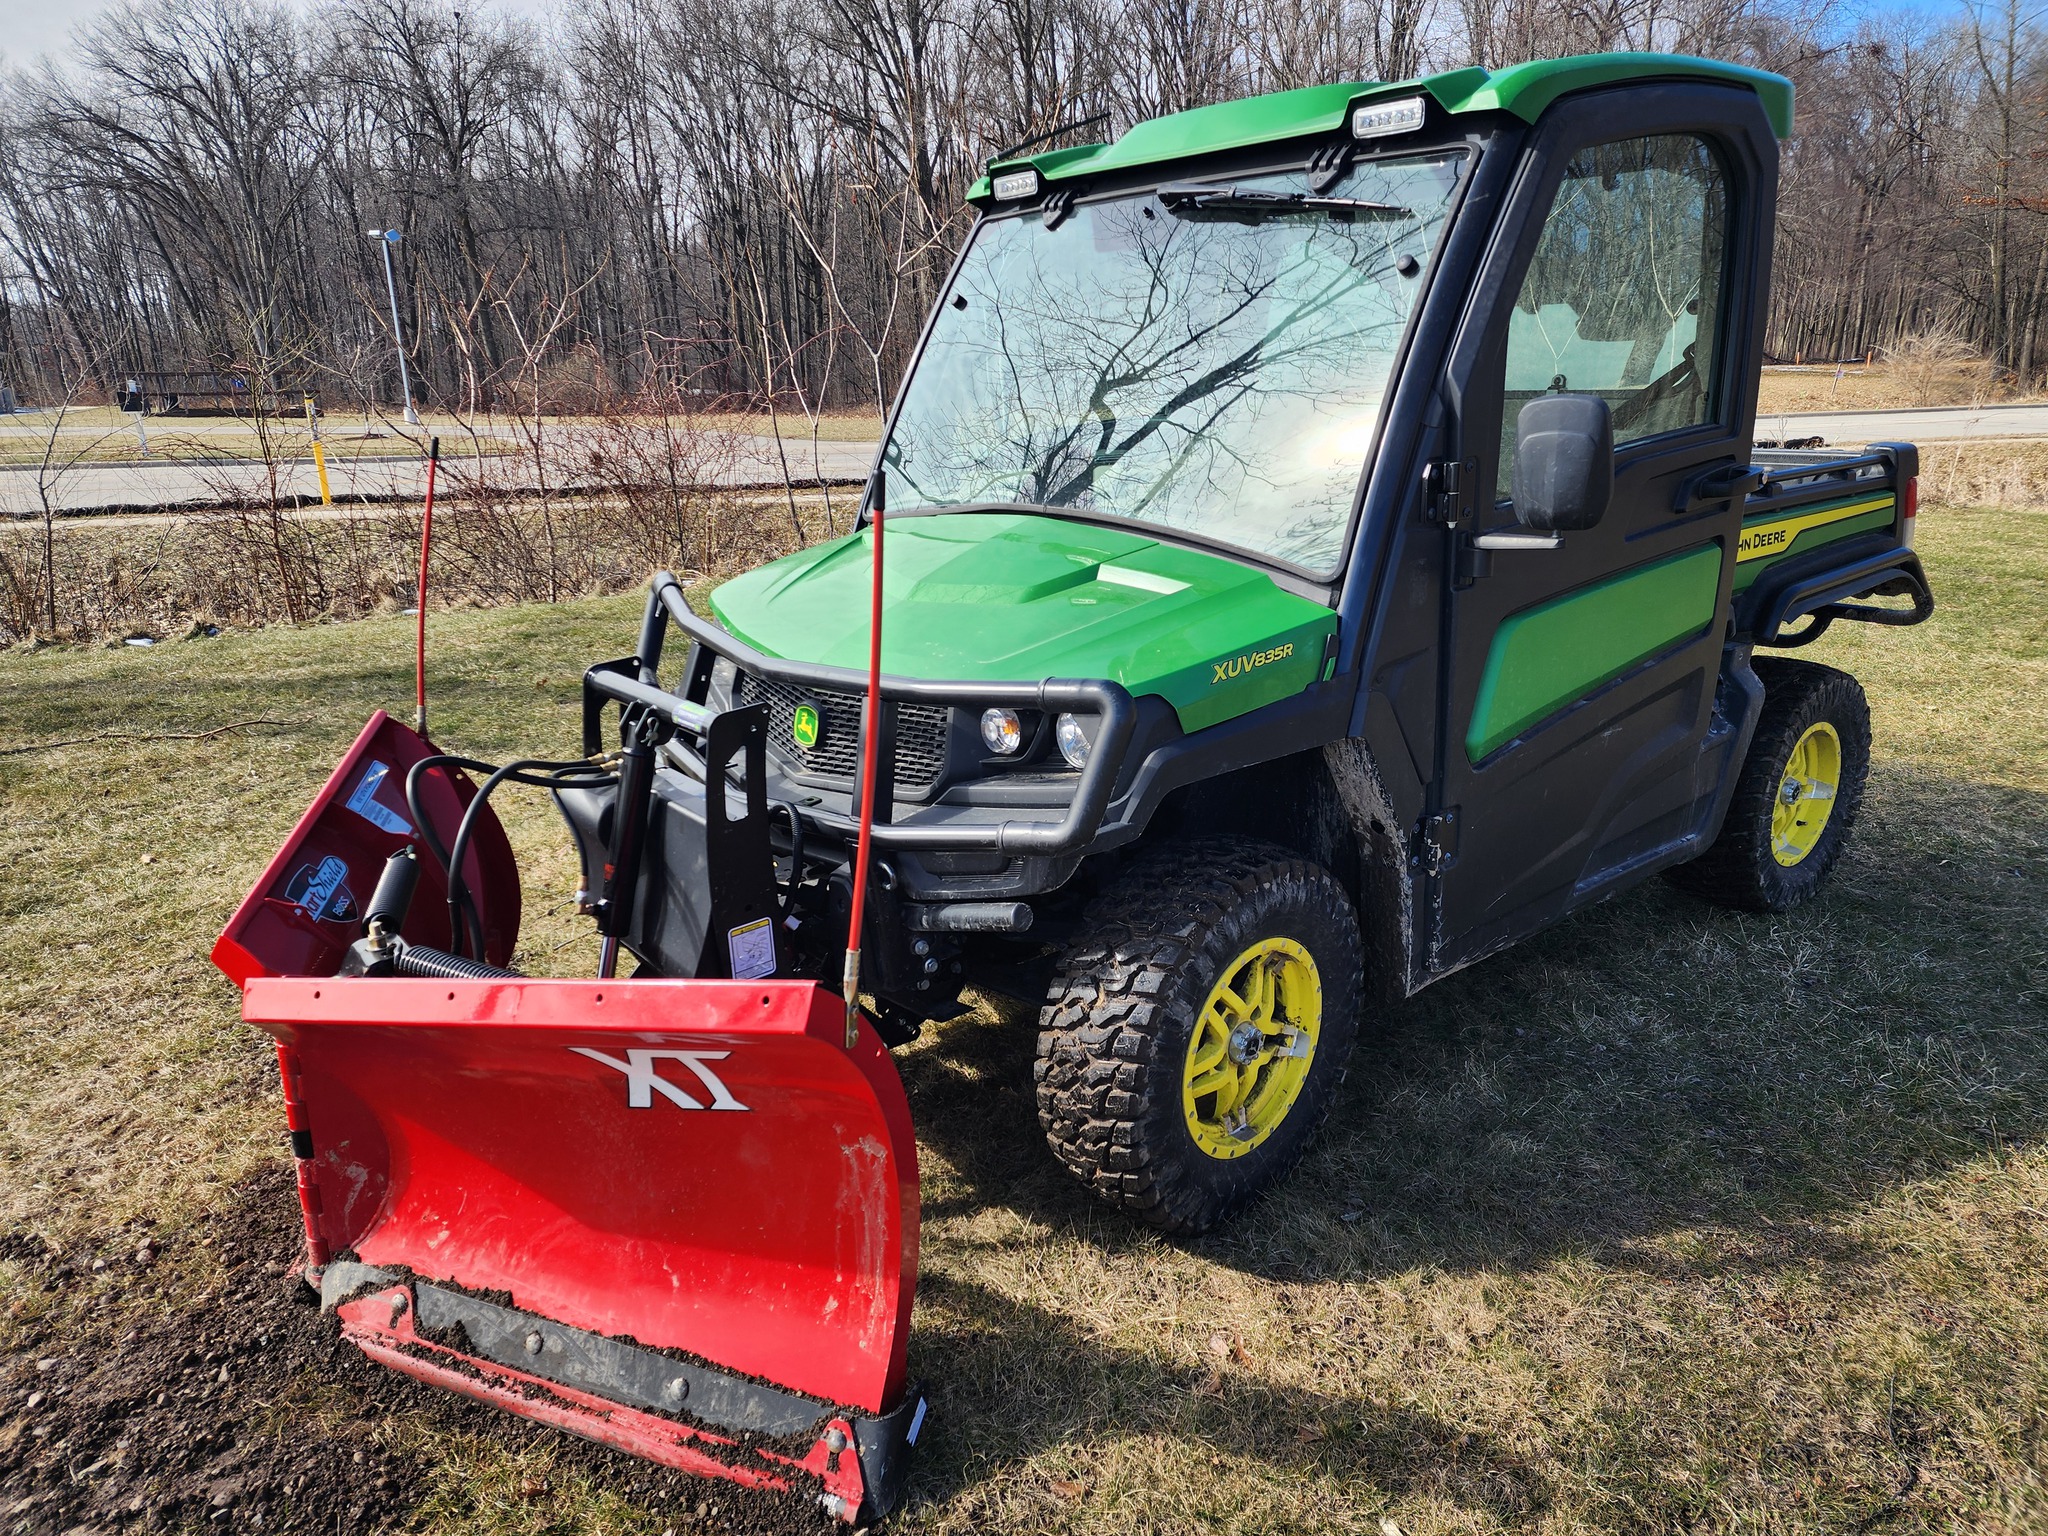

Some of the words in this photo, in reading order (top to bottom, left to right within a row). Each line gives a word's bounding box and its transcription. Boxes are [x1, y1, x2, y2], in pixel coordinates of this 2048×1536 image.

[1738, 537, 1751, 551] HN
[1753, 530, 1786, 549] DEERE
[1211, 643, 1294, 684] XUV835R
[333, 895, 350, 916] BOSS
